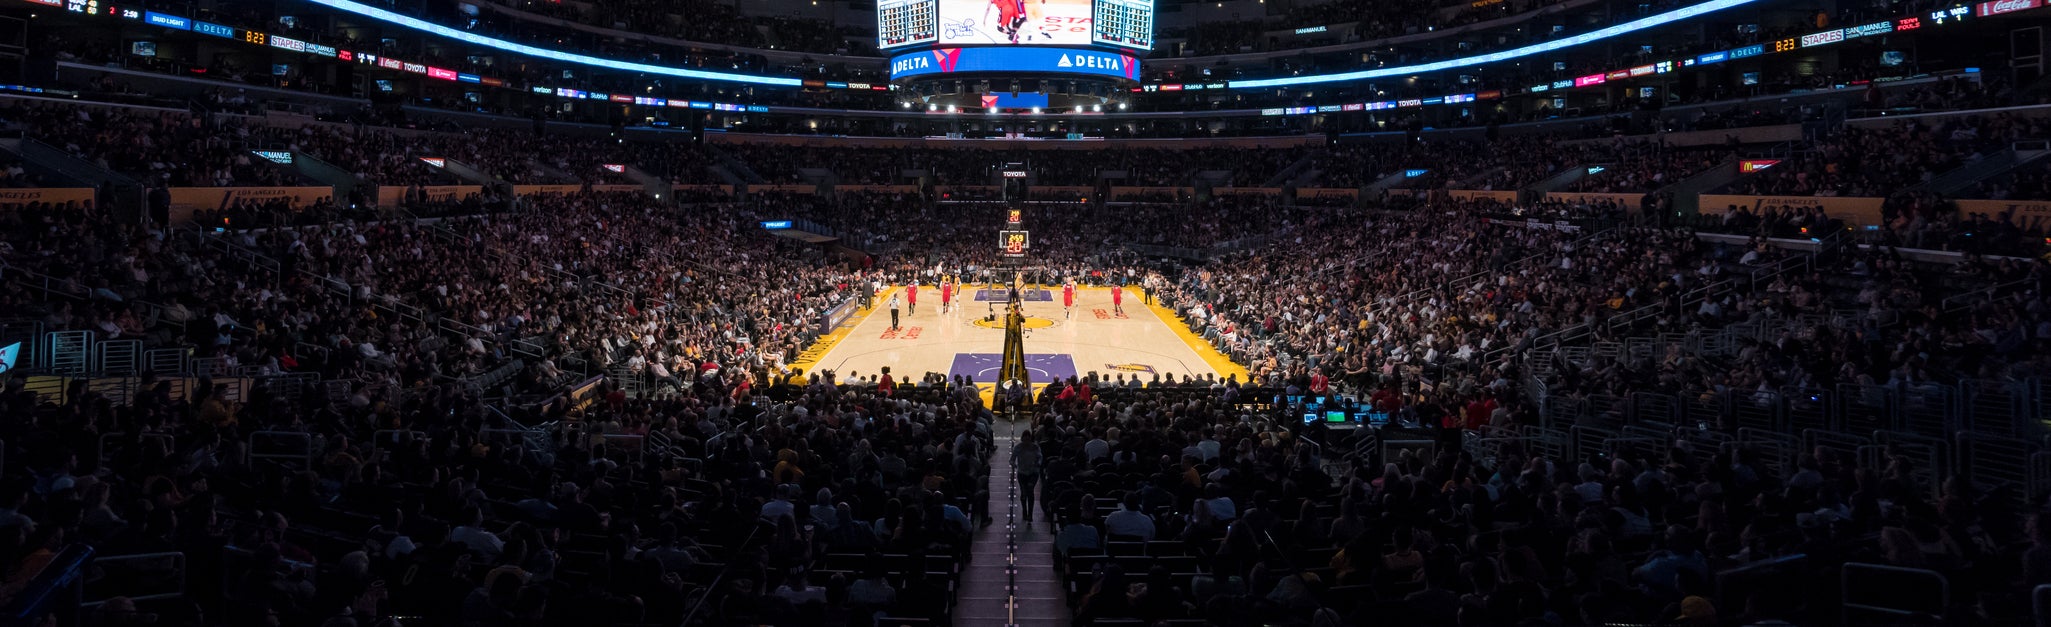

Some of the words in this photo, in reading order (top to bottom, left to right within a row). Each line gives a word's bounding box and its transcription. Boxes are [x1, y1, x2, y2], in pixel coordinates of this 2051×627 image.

[68, 3, 83, 12] LAL
[1931, 11, 1947, 19] LAL
[152, 15, 168, 24] BUD
[167, 18, 184, 27] LIGHT
[1899, 17, 1918, 25] TEAM
[203, 24, 232, 36] DELTA
[1845, 26, 1858, 35] SAN
[1863, 21, 1892, 32] MANUEL
[1897, 22, 1920, 31] FOULS
[246, 31, 265, 45] 8:23
[1803, 31, 1843, 46] STAPLES
[271, 36, 304, 51] STAPLES
[1775, 38, 1795, 52] 8:23
[1737, 46, 1762, 56] DELTA
[403, 63, 427, 73] TOYOTA
[897, 57, 929, 72] DELTA
[1075, 56, 1119, 70] DELTA
[533, 86, 552, 94] verizon
[1531, 84, 1549, 92] verizon
[1398, 99, 1421, 107] TOYOTA
[268, 151, 292, 159] MANUEL
[0, 191, 41, 199] NGELES
[1007, 241, 1022, 252] 20
